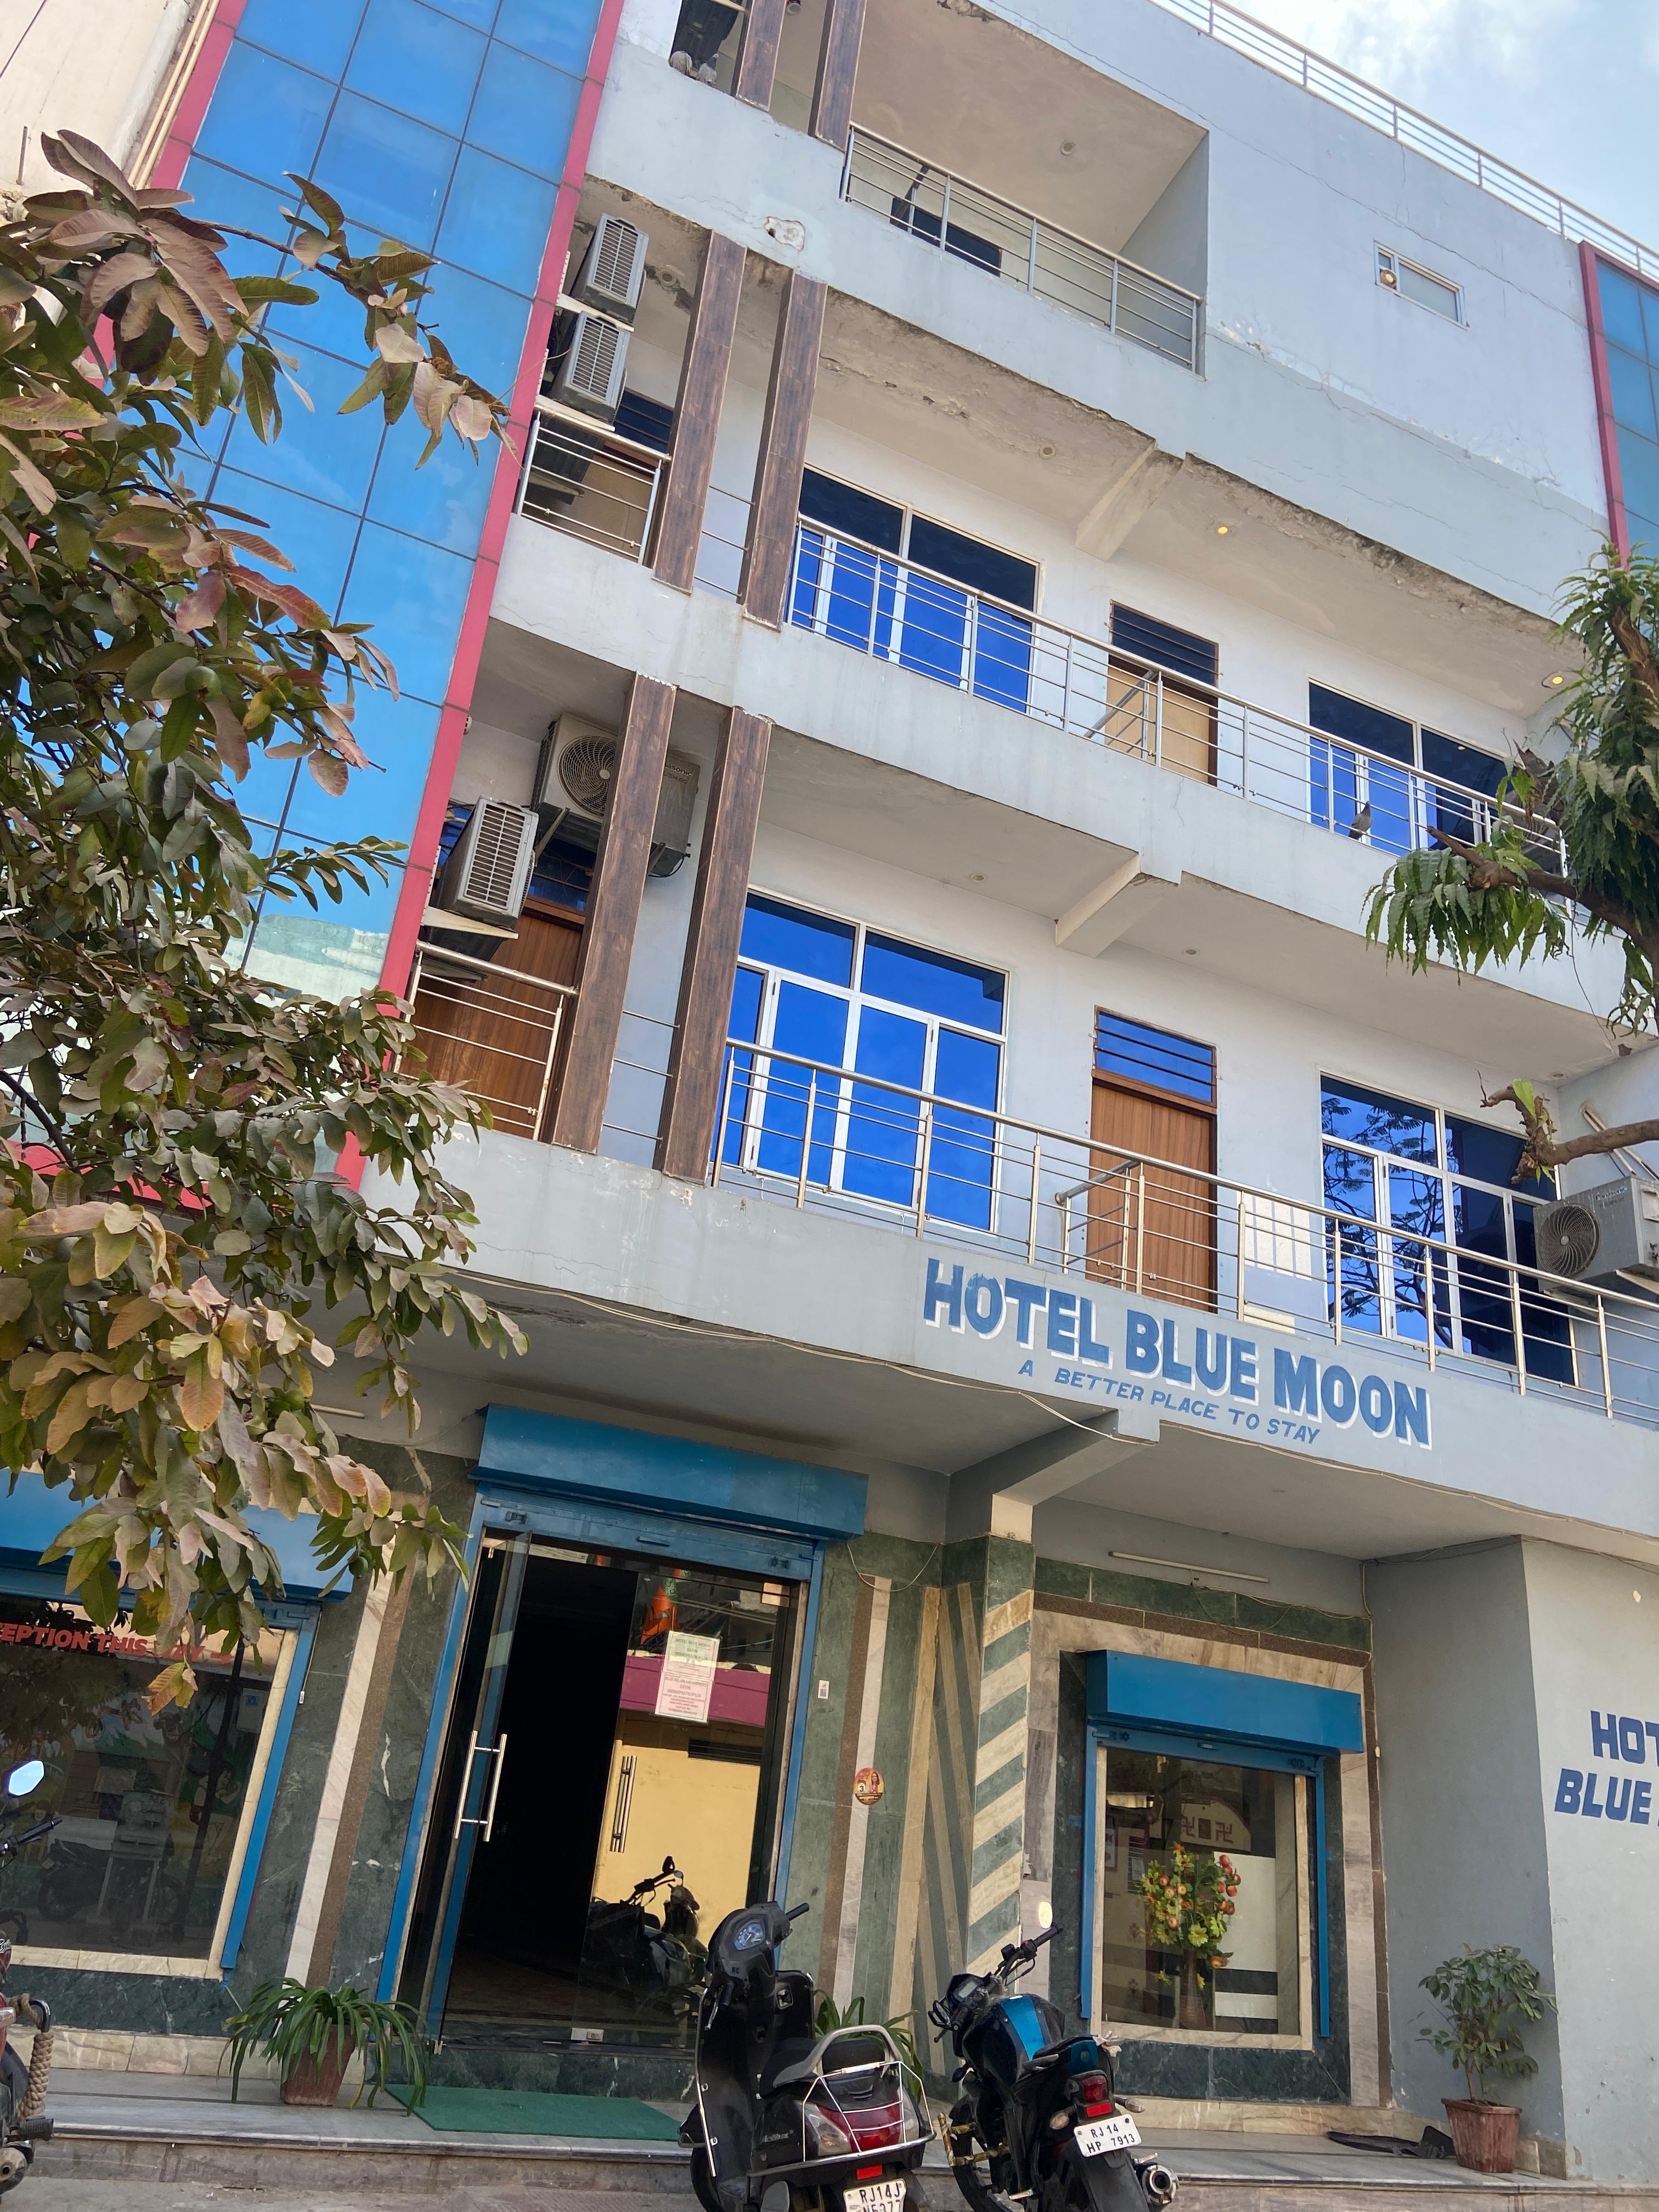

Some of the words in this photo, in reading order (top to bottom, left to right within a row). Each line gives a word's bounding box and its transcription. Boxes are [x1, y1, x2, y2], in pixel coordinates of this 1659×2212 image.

[665, 763, 692, 777] asonic
[924, 1258, 1113, 1368] HOTEL
[1126, 1309, 1259, 1406] BLUE
[1274, 1348, 1432, 1449] MOON
[1018, 1359, 1034, 1377] A
[1054, 1367, 1144, 1402] BETTER
[1150, 1390, 1220, 1420] PLACE
[1228, 1408, 1259, 1430] TO
[1267, 1418, 1321, 1444] STAY
[0, 1622, 91, 1650] EPTION
[94, 1633, 148, 1656] THIS
[1554, 1768, 1652, 1825] BLUE
[1086, 2141, 1102, 2153] HP
[1111, 2134, 1135, 2147] 7913
[859, 2182, 900, 2203] RJ14J
